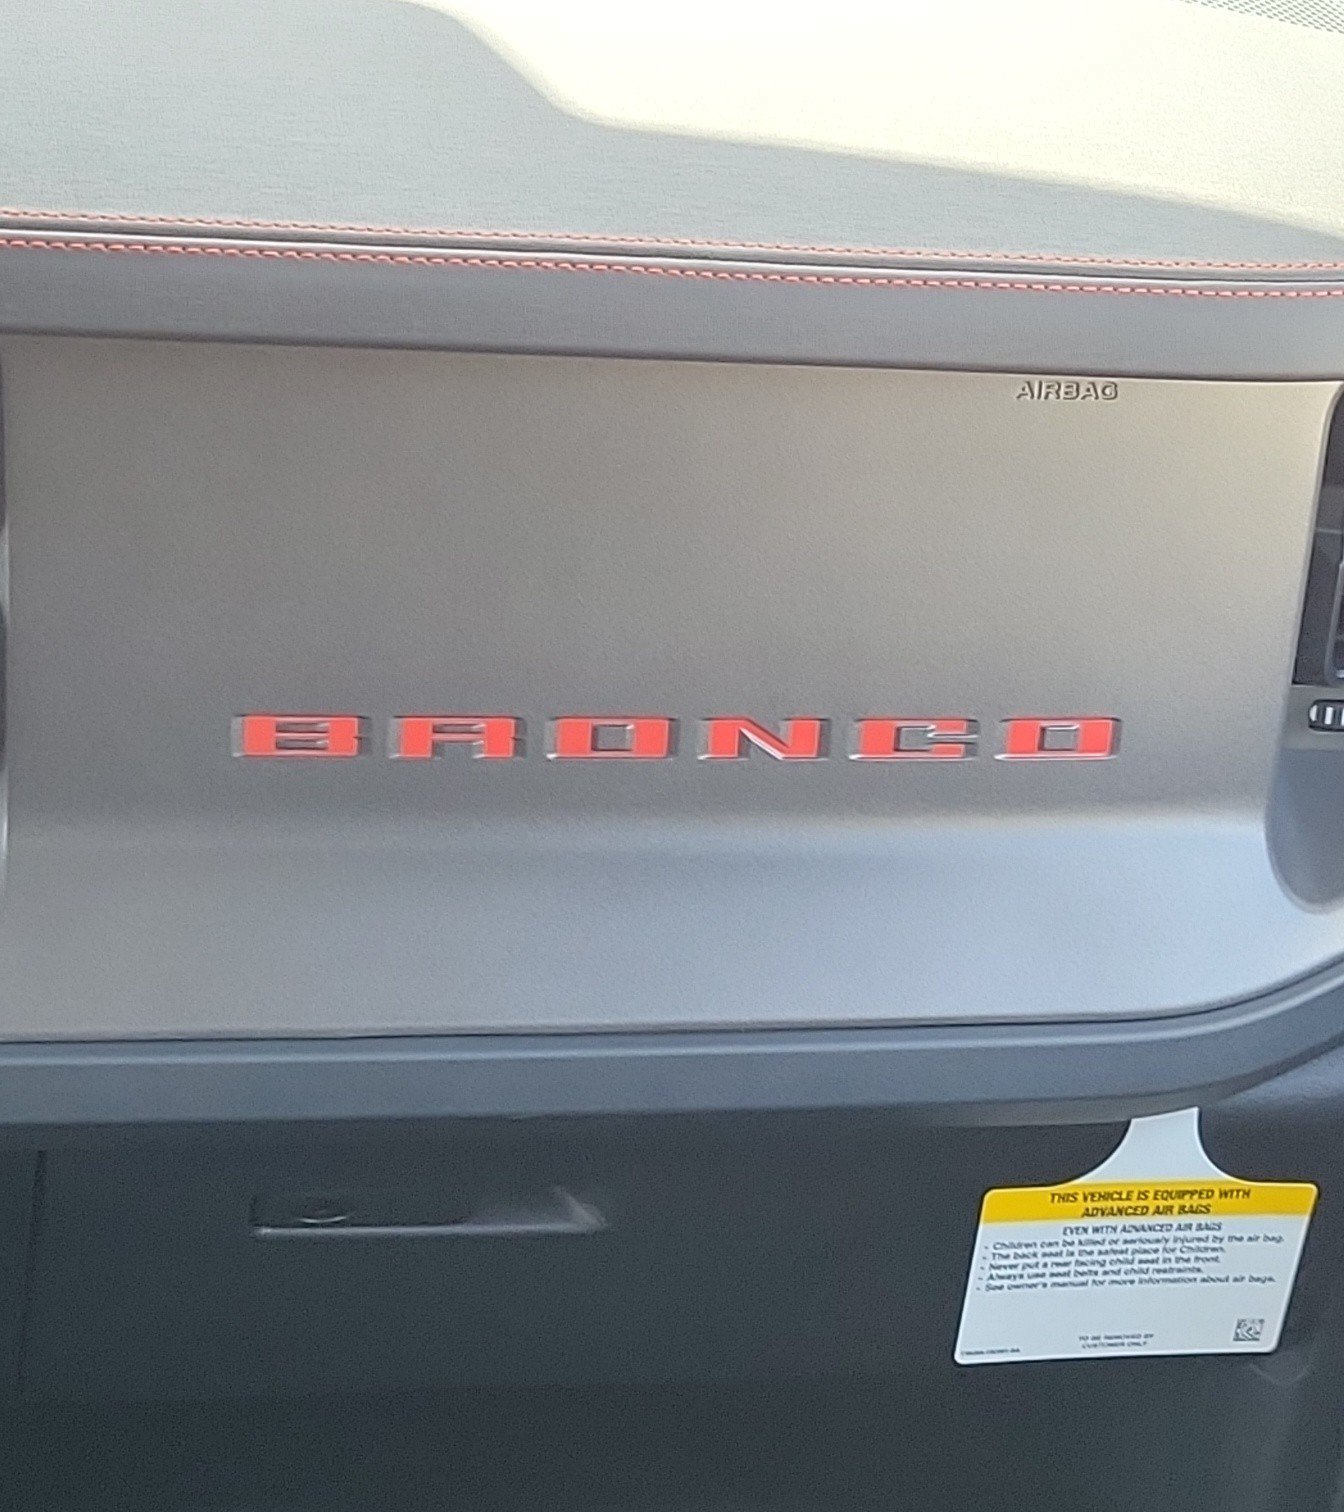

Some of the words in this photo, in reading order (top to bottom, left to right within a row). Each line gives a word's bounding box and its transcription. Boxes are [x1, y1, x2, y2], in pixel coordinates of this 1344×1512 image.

[1016, 380, 1118, 401] AIRBAG
[233, 714, 1122, 762] BRONCO
[1050, 1192, 1079, 1203] THIS
[1082, 1190, 1134, 1202] VEHICLE
[1137, 1190, 1149, 1201] IS
[1153, 1189, 1215, 1201] EQUIPPED
[1218, 1188, 1252, 1199] WITH
[1081, 1205, 1150, 1218] ADVANCED
[1152, 1204, 1175, 1216] AIR
[1178, 1204, 1212, 1215] BAGS
[1062, 1226, 1089, 1236] EVEN
[1091, 1225, 1118, 1235] WITH
[1120, 1223, 1174, 1234] ADVANCED
[1175, 1222, 1193, 1232] AIR
[1195, 1222, 1223, 1232] BAGS
[992, 1241, 1037, 1251] Children
[1062, 1239, 1075, 1247] be
[1077, 1238, 1106, 1247] killed
[1122, 1237, 1170, 1246] seriously
[1172, 1236, 1210, 1245] injured
[1212, 1235, 1225, 1244] by
[1227, 1234, 1244, 1242] the
[1247, 1234, 1260, 1242] air
[991, 1252, 1010, 1260] The
[1013, 1251, 1038, 1259] back
[1131, 1247, 1159, 1256] place
[989, 1263, 1019, 1271] Never
[1021, 1262, 1039, 1271] put
[1074, 1259, 1107, 1268] facing
[1109, 1257, 1134, 1266] child
[1138, 1257, 1160, 1265] seat
[1174, 1255, 1191, 1263] the
[987, 1273, 1024, 1282] Always
[1102, 1268, 1121, 1276] and
[1123, 1267, 1150, 1275] child
[985, 1283, 1004, 1292] See
[1050, 1279, 1088, 1288] manual
[1091, 1278, 1106, 1286] for
[1138, 1276, 1198, 1285] information
[1200, 1275, 1229, 1283] about
[1232, 1275, 1245, 1283] air
